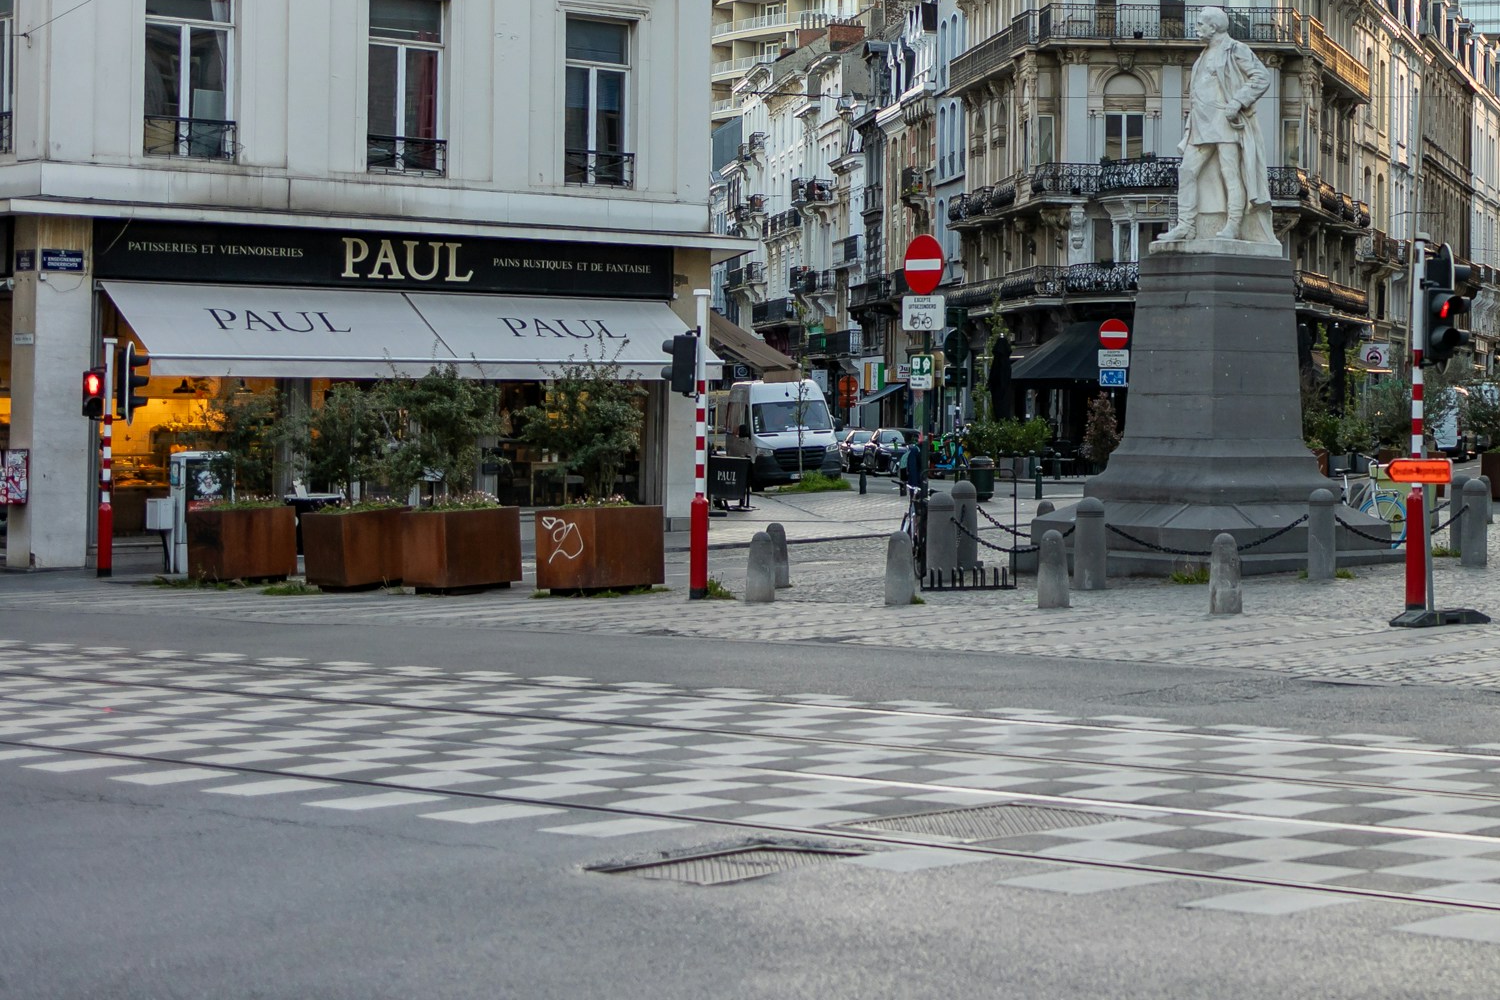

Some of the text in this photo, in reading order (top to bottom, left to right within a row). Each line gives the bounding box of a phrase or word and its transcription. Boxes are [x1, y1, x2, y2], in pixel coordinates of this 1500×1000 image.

[127, 241, 304, 258] PATISSERIES ET VIENNOISERIES
[341, 237, 474, 283] PAUL
[493, 257, 652, 275] PAINS RUSTIQUES ET DE FANTAISIE
[203, 307, 352, 333] PAUL
[498, 317, 627, 339] PAUL
[717, 470, 737, 482] PAUL
